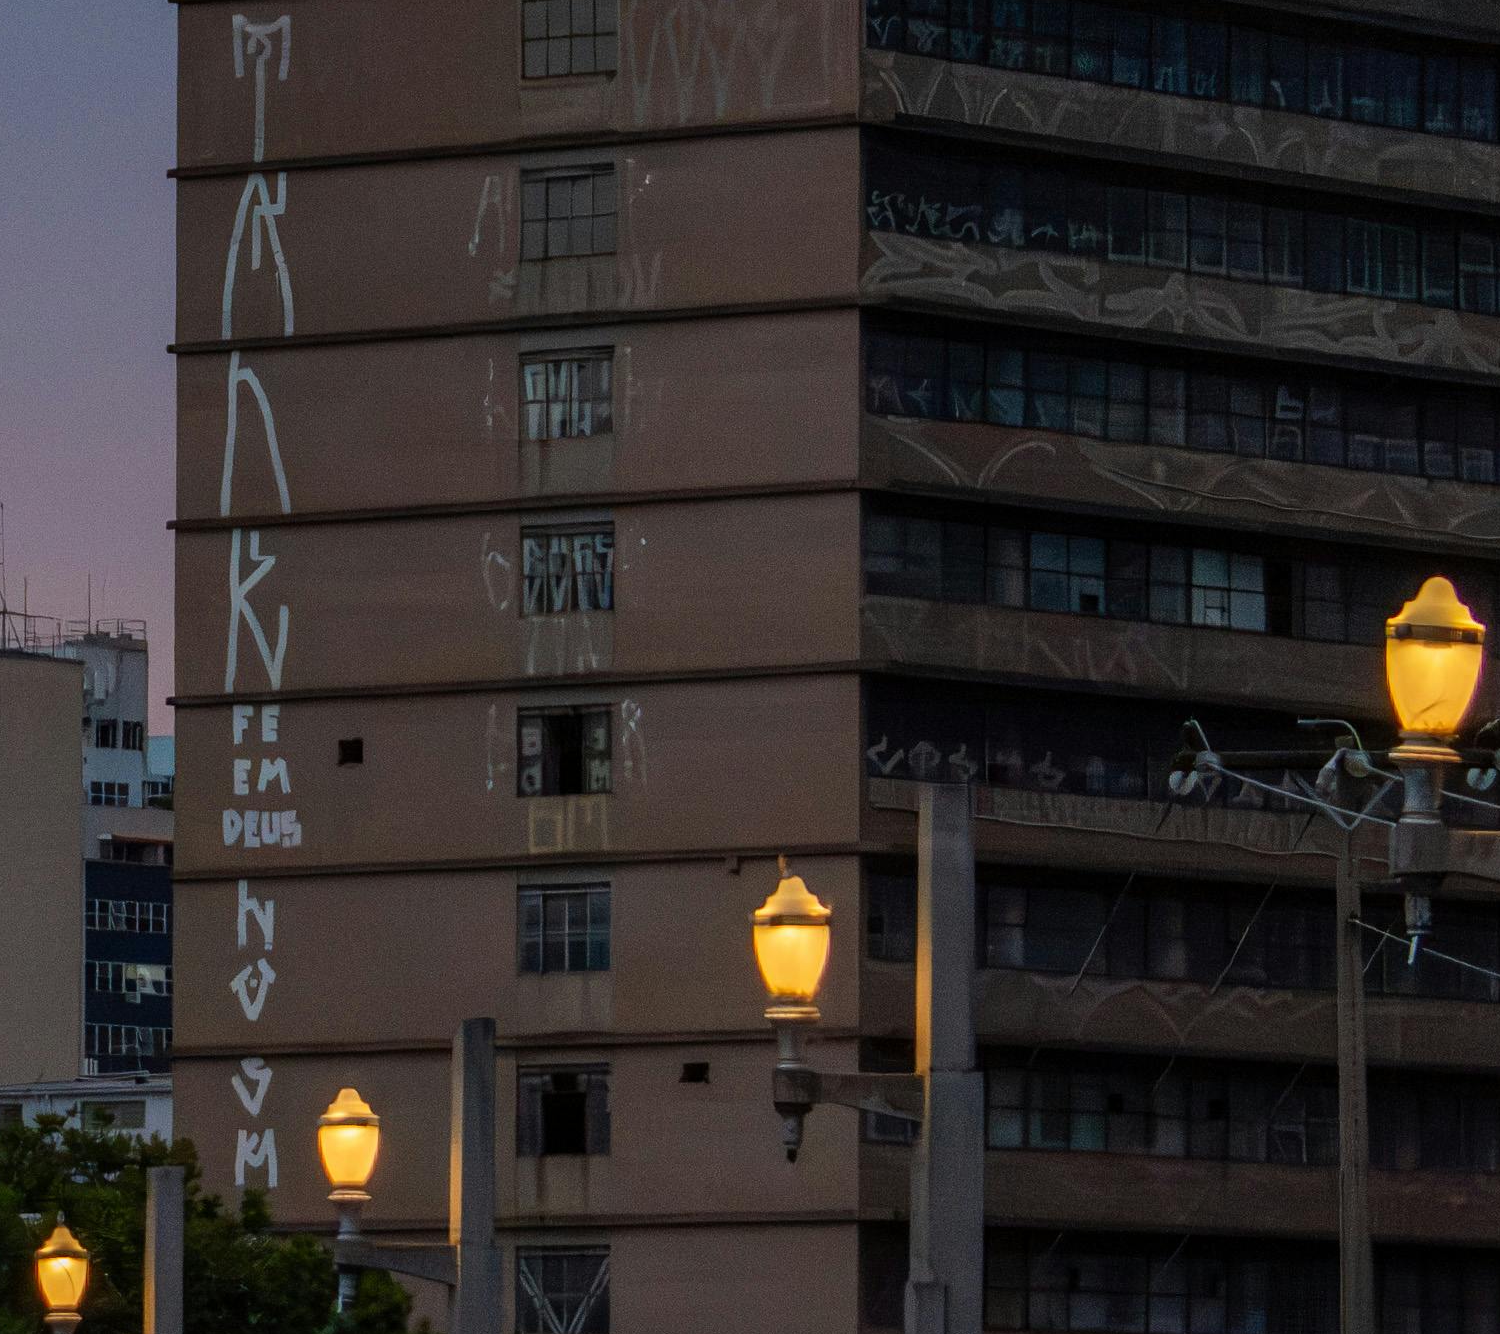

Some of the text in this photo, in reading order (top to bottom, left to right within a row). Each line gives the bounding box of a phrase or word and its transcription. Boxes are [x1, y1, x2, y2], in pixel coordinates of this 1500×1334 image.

[233, 704, 279, 744] FE
[233, 758, 292, 795] EM
[223, 809, 303, 847] DEUS
